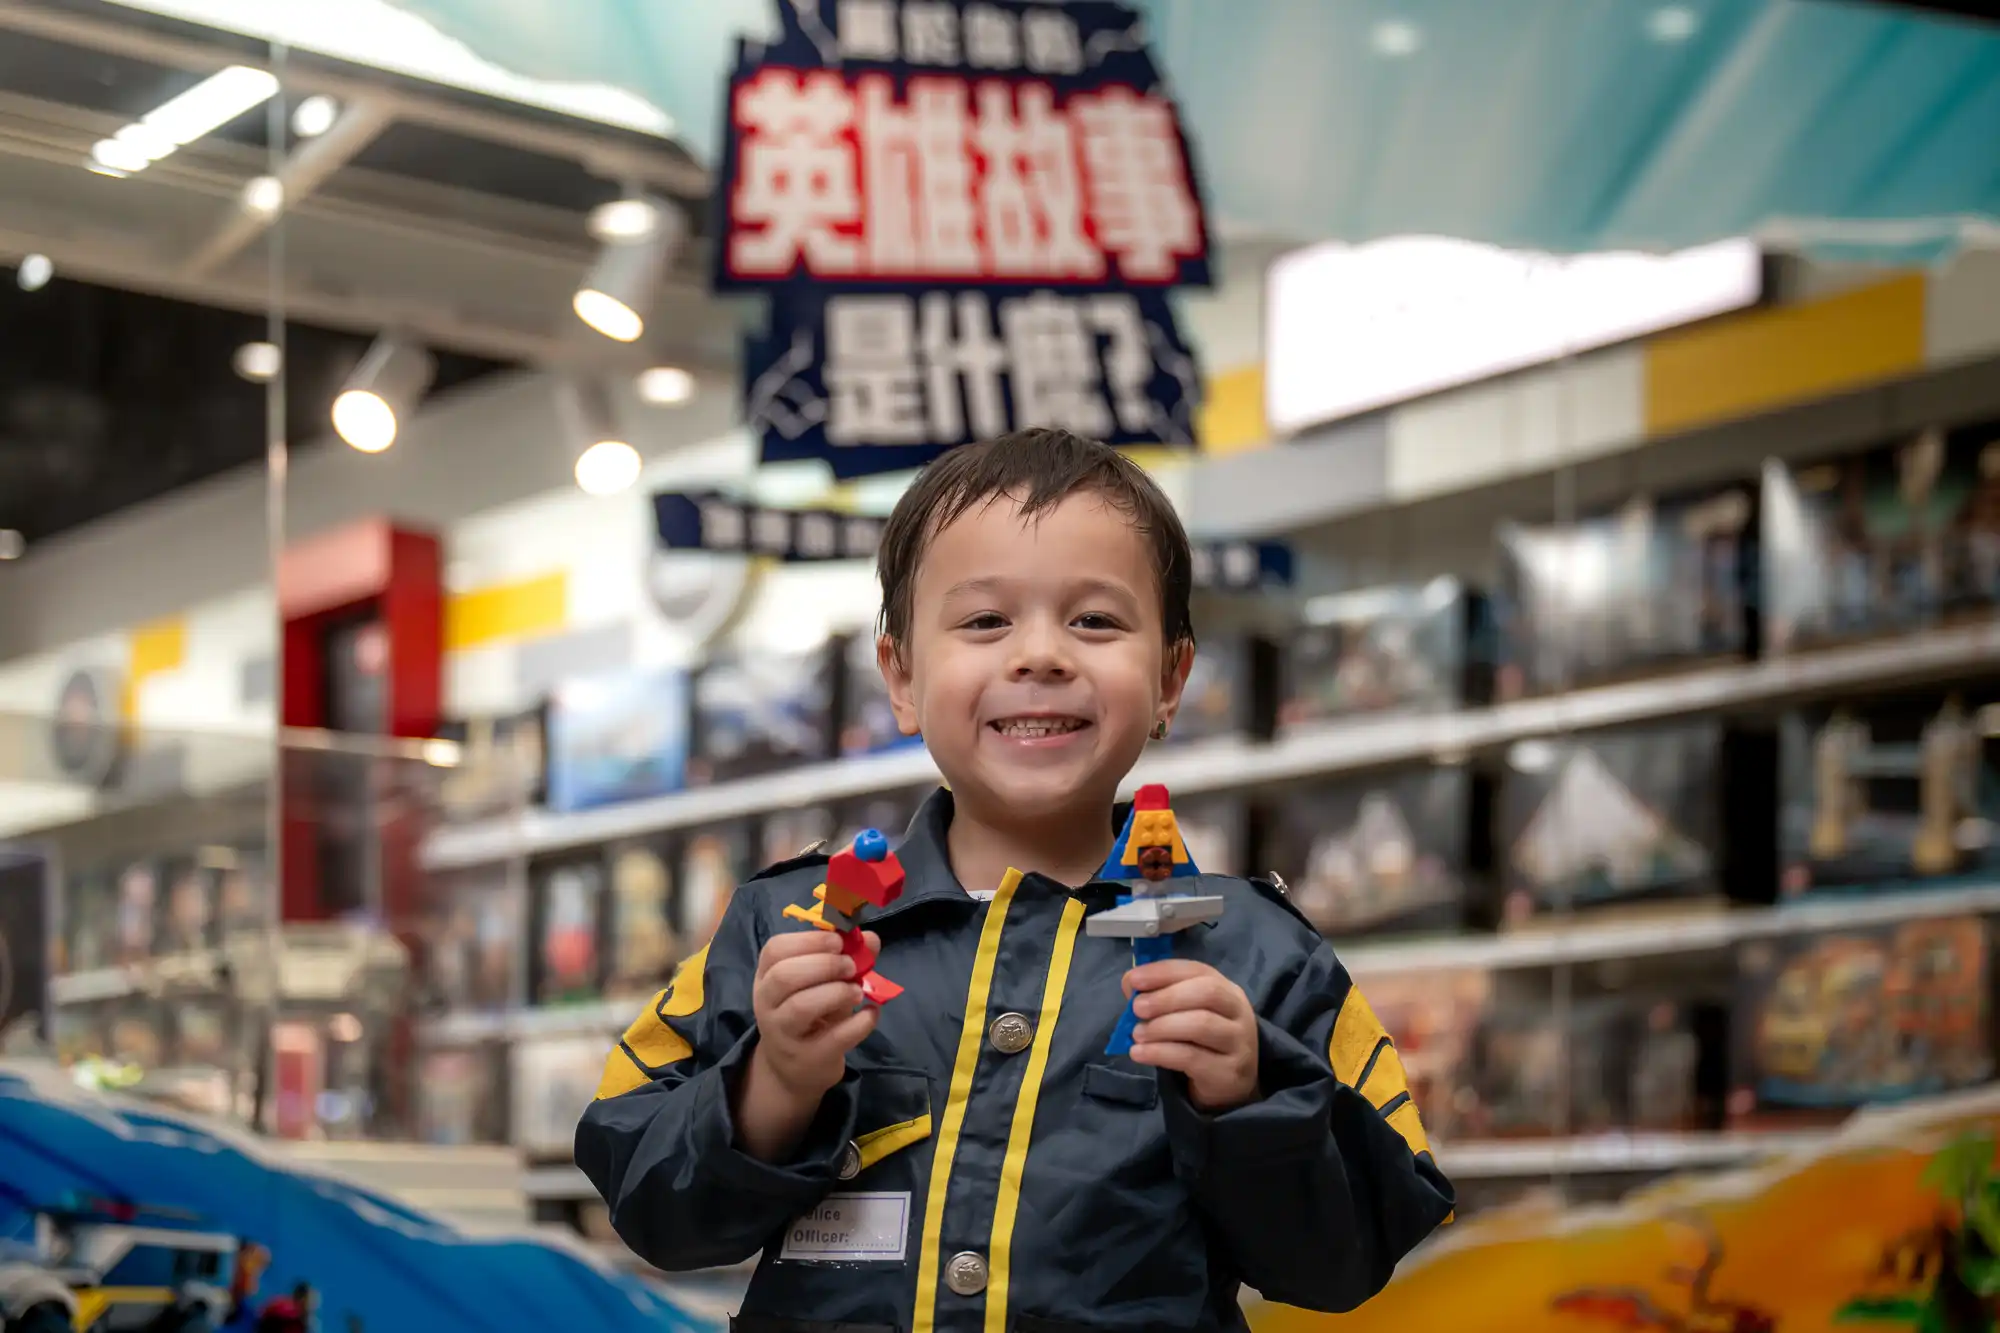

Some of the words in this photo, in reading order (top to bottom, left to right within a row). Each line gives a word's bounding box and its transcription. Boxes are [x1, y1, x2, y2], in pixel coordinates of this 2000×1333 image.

[728, 67, 1203, 282] 英雄故事
[804, 1207, 841, 1221] olice
